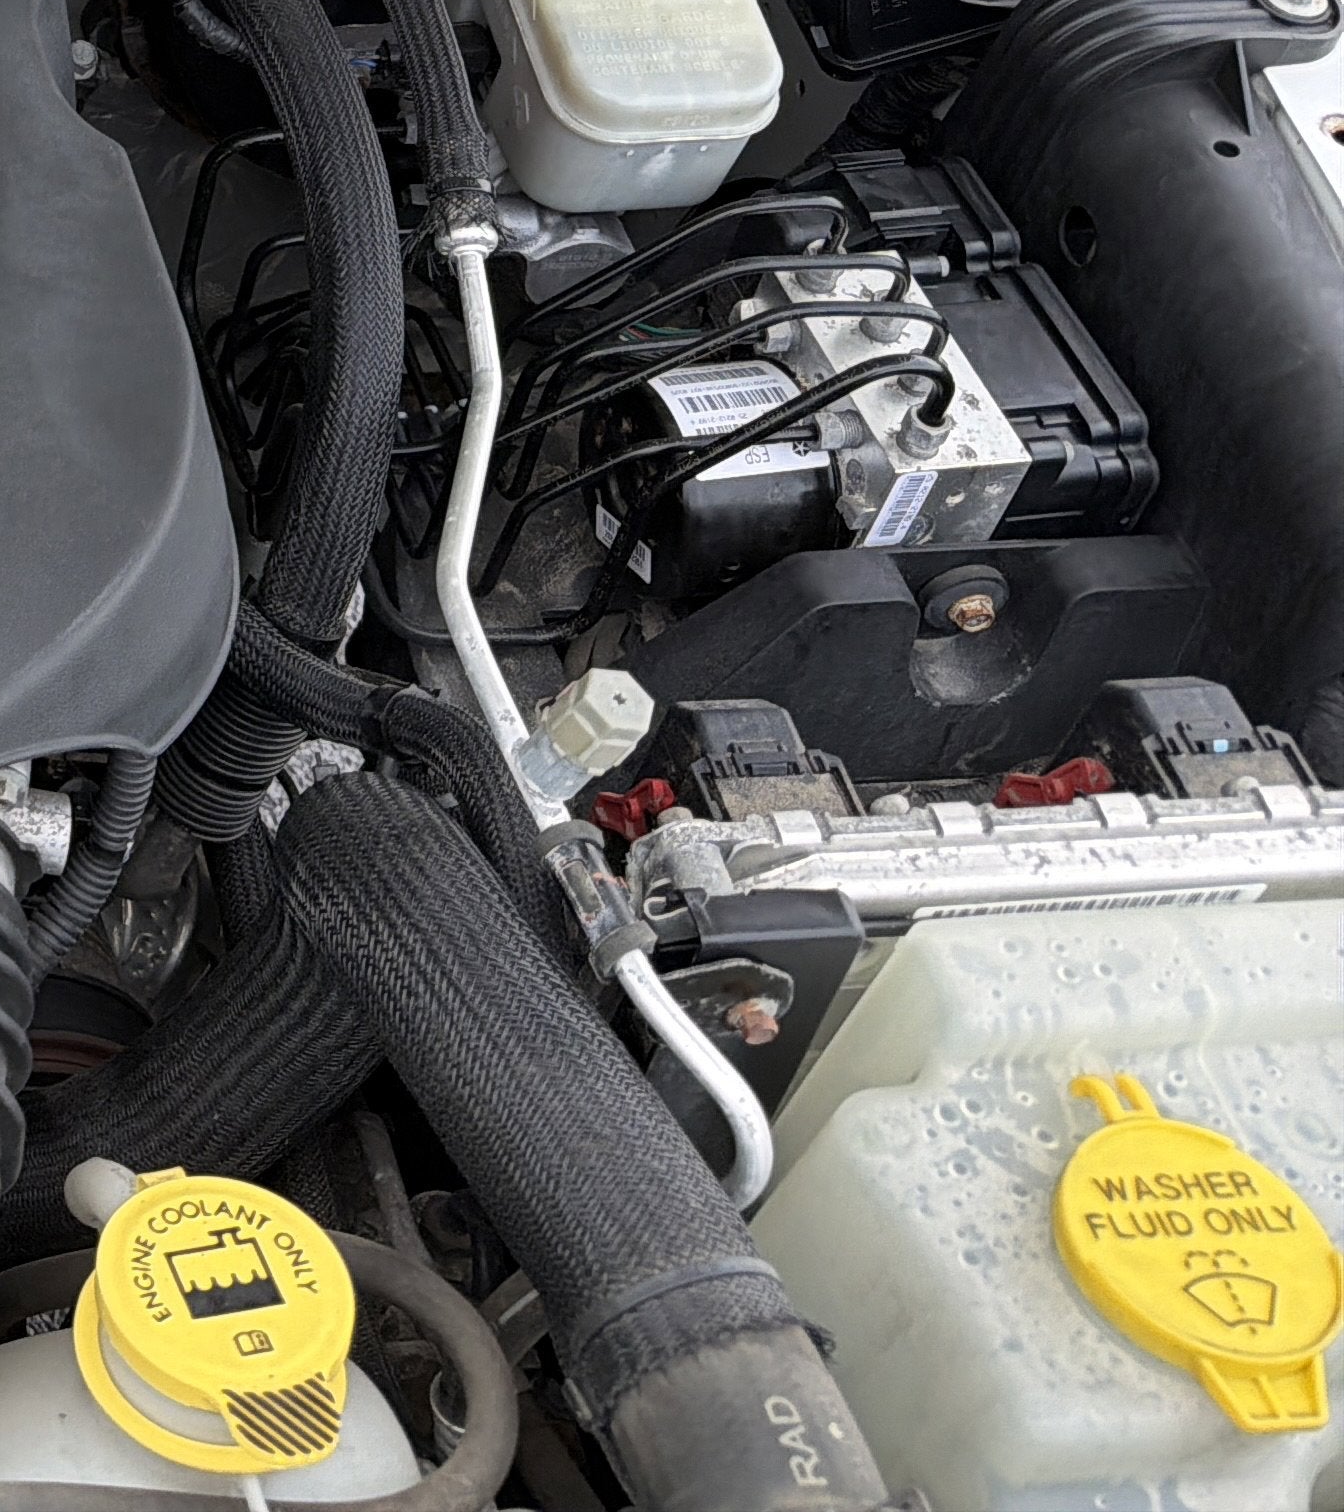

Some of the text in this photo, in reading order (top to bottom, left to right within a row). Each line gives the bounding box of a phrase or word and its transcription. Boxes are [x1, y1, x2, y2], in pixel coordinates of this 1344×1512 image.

[744, 445, 771, 465] ESP
[1090, 1170, 1259, 1203] WASHER
[1085, 1205, 1298, 1241] FLUID ONLY
[132, 1199, 320, 1323] ENGINE COOLANT ONLY
[763, 1394, 829, 1489] RAD
